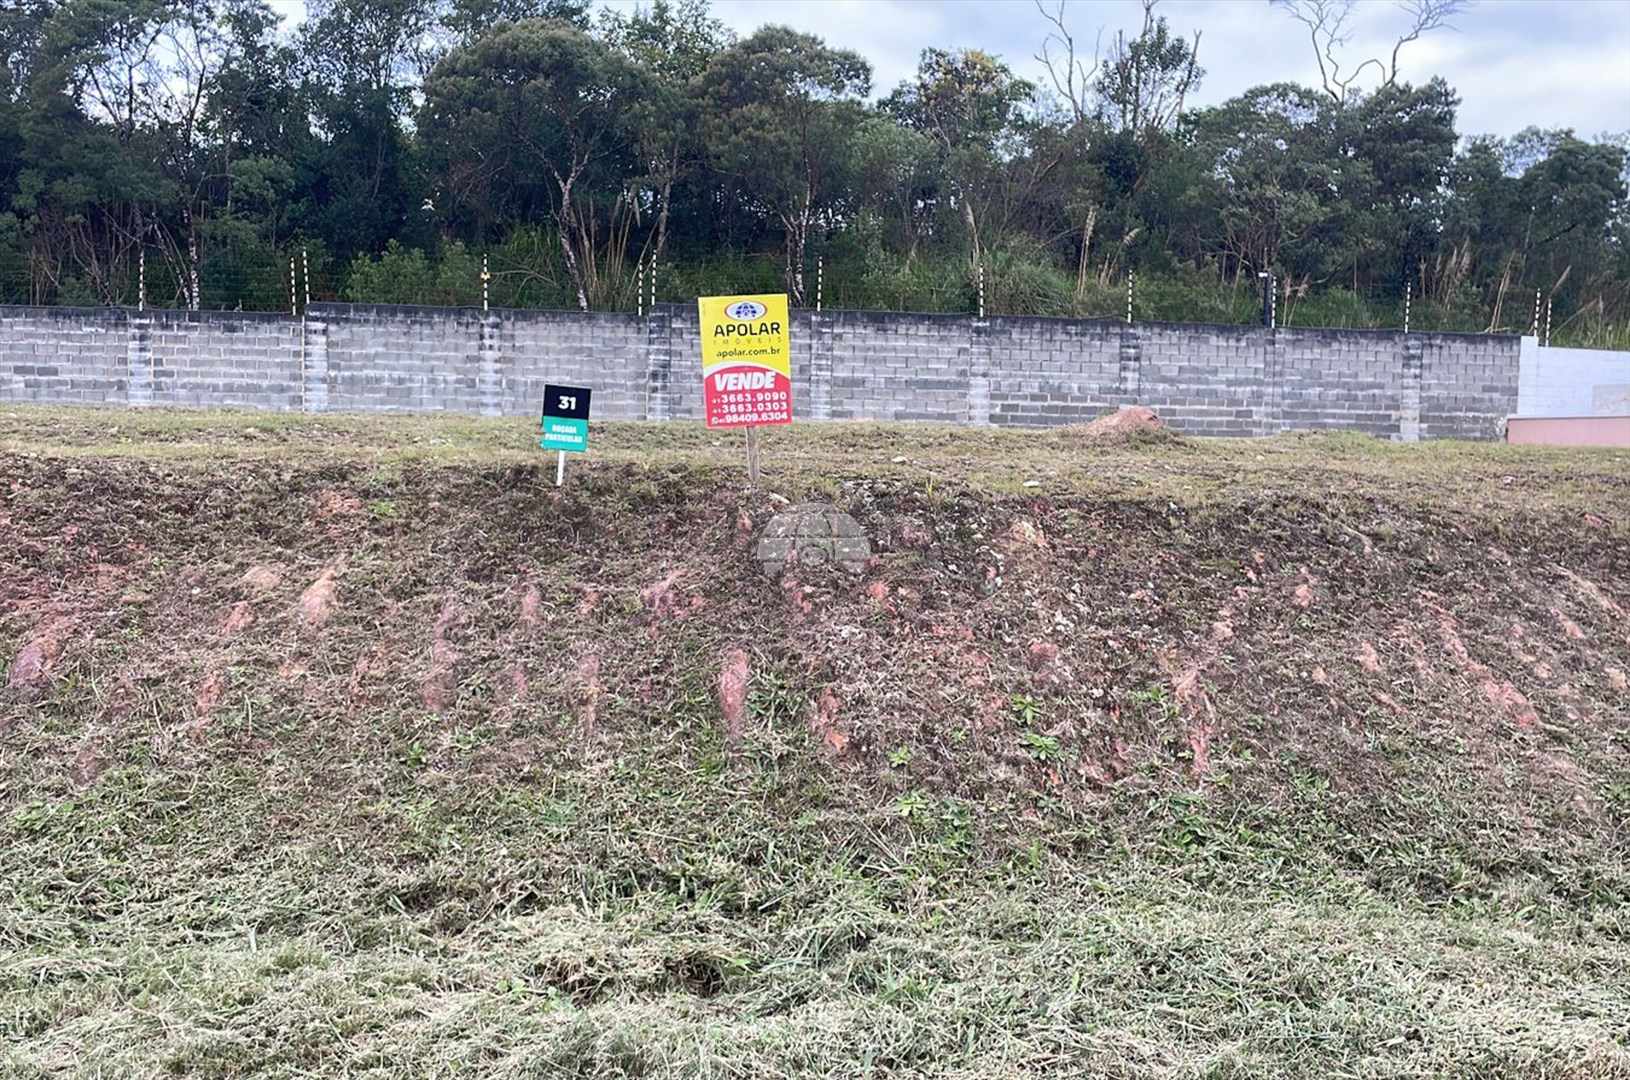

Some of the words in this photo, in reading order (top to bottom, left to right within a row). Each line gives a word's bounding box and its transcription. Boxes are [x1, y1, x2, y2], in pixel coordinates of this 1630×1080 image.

[714, 322, 781, 337] APOLAR
[713, 337, 782, 345] IMÓVEIS
[716, 346, 780, 359] apolar.com.br
[714, 371, 776, 392] VENDE
[558, 395, 577, 410] 31
[721, 391, 787, 403] 3663.9090
[721, 401, 788, 413] 3663.0303
[725, 411, 788, 423] 98409.6304
[545, 433, 583, 443] PARTICULAR
